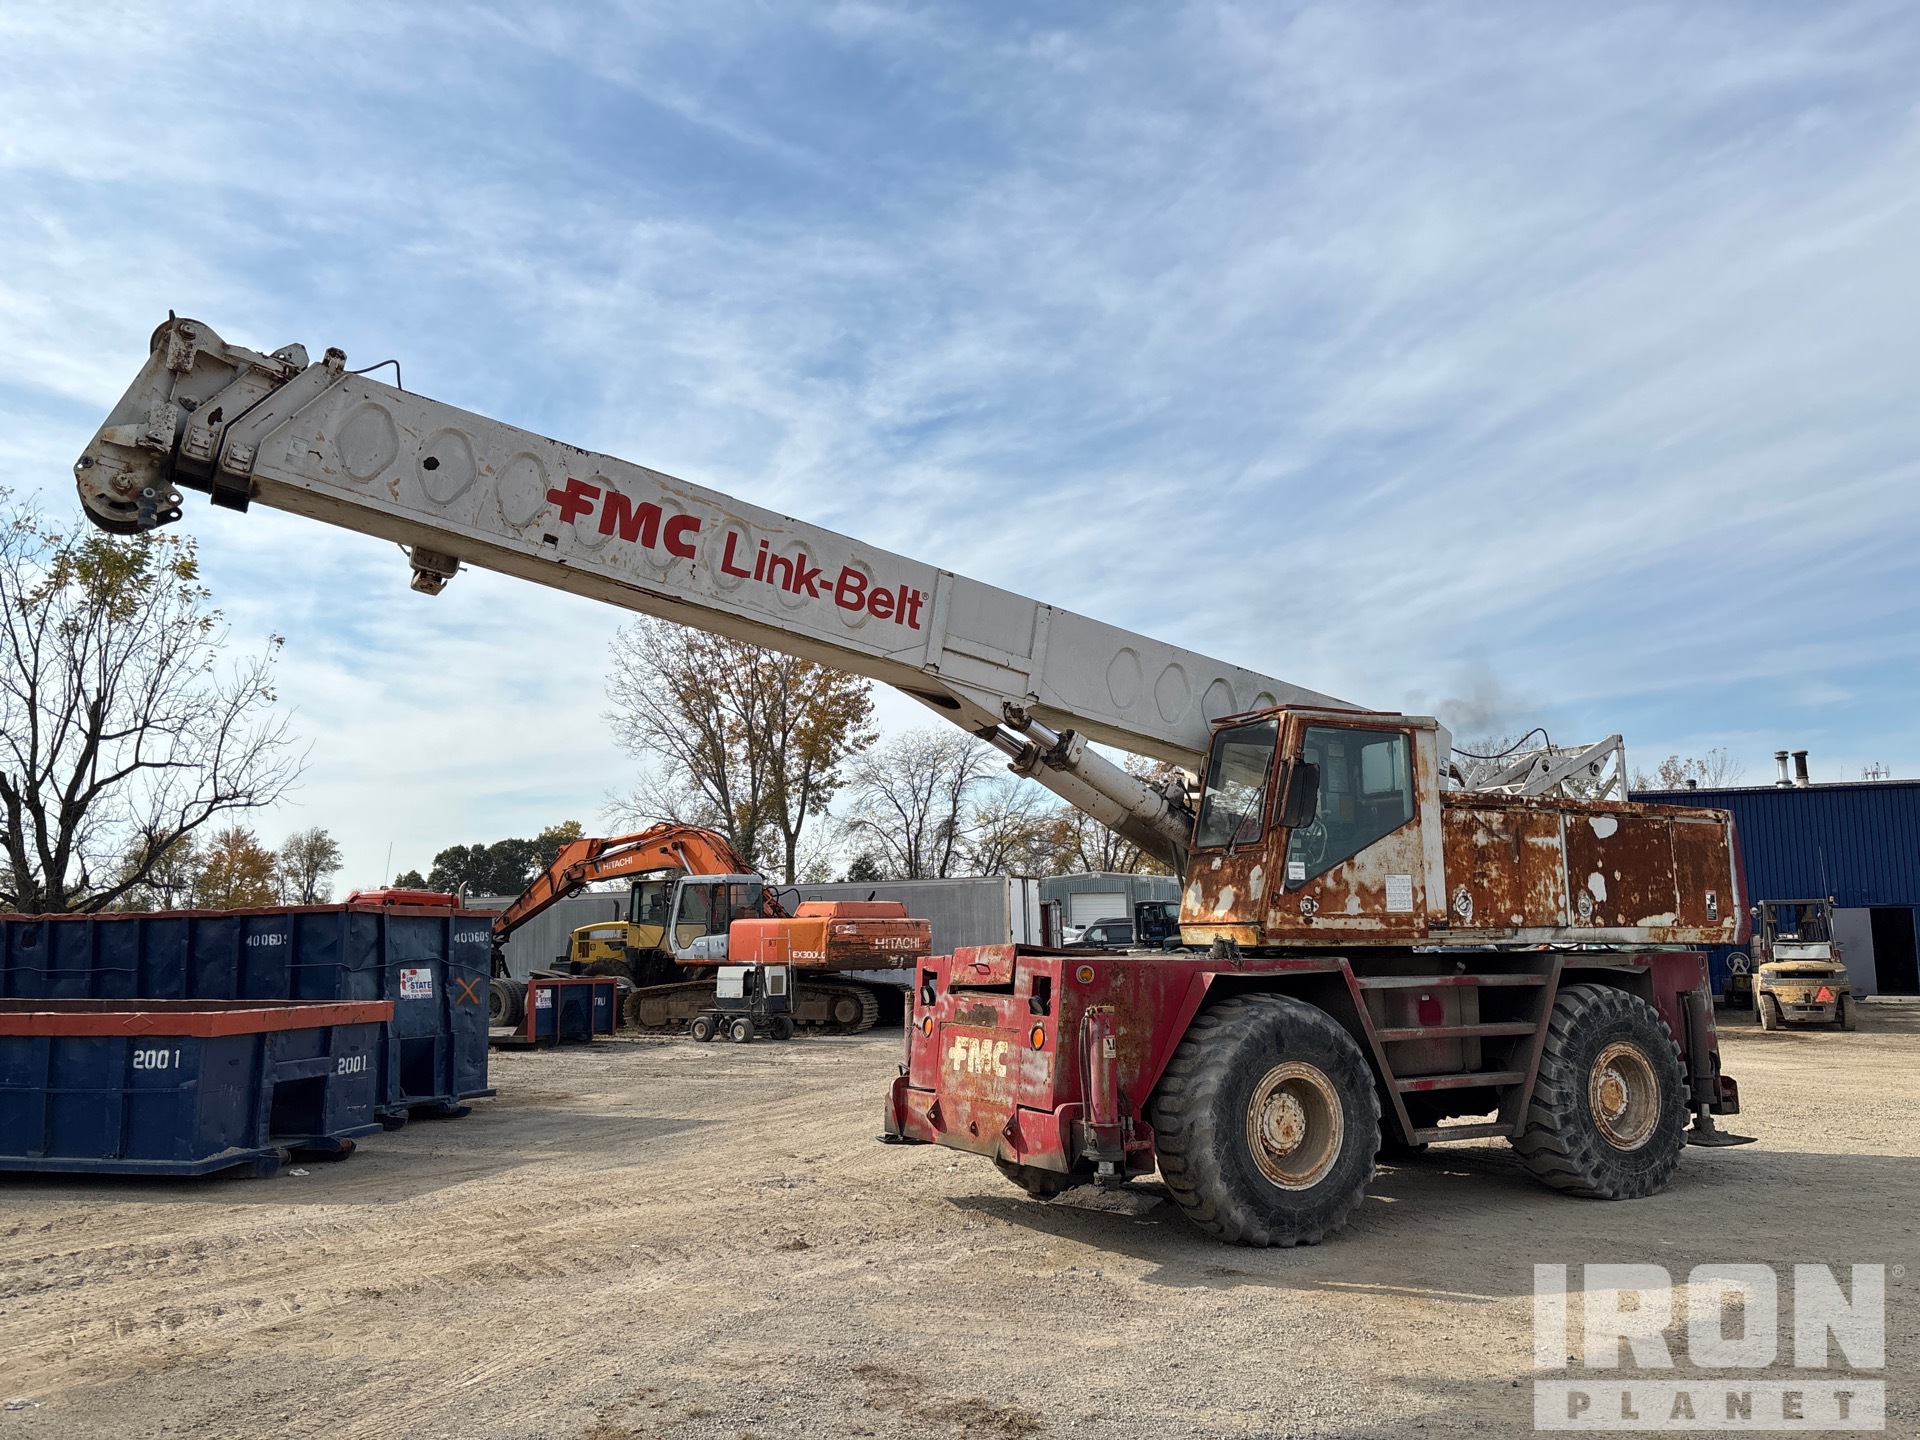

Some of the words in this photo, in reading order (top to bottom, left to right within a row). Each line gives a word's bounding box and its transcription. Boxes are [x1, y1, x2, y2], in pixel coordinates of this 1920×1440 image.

[546, 477, 702, 560] FMC
[603, 856, 633, 871] HITACHI
[875, 937, 920, 950] HITACHI
[410, 981, 432, 990] STATE
[133, 1049, 181, 1070] 2001
[337, 1054, 367, 1076] 2001
[948, 1035, 1009, 1078] FMC
